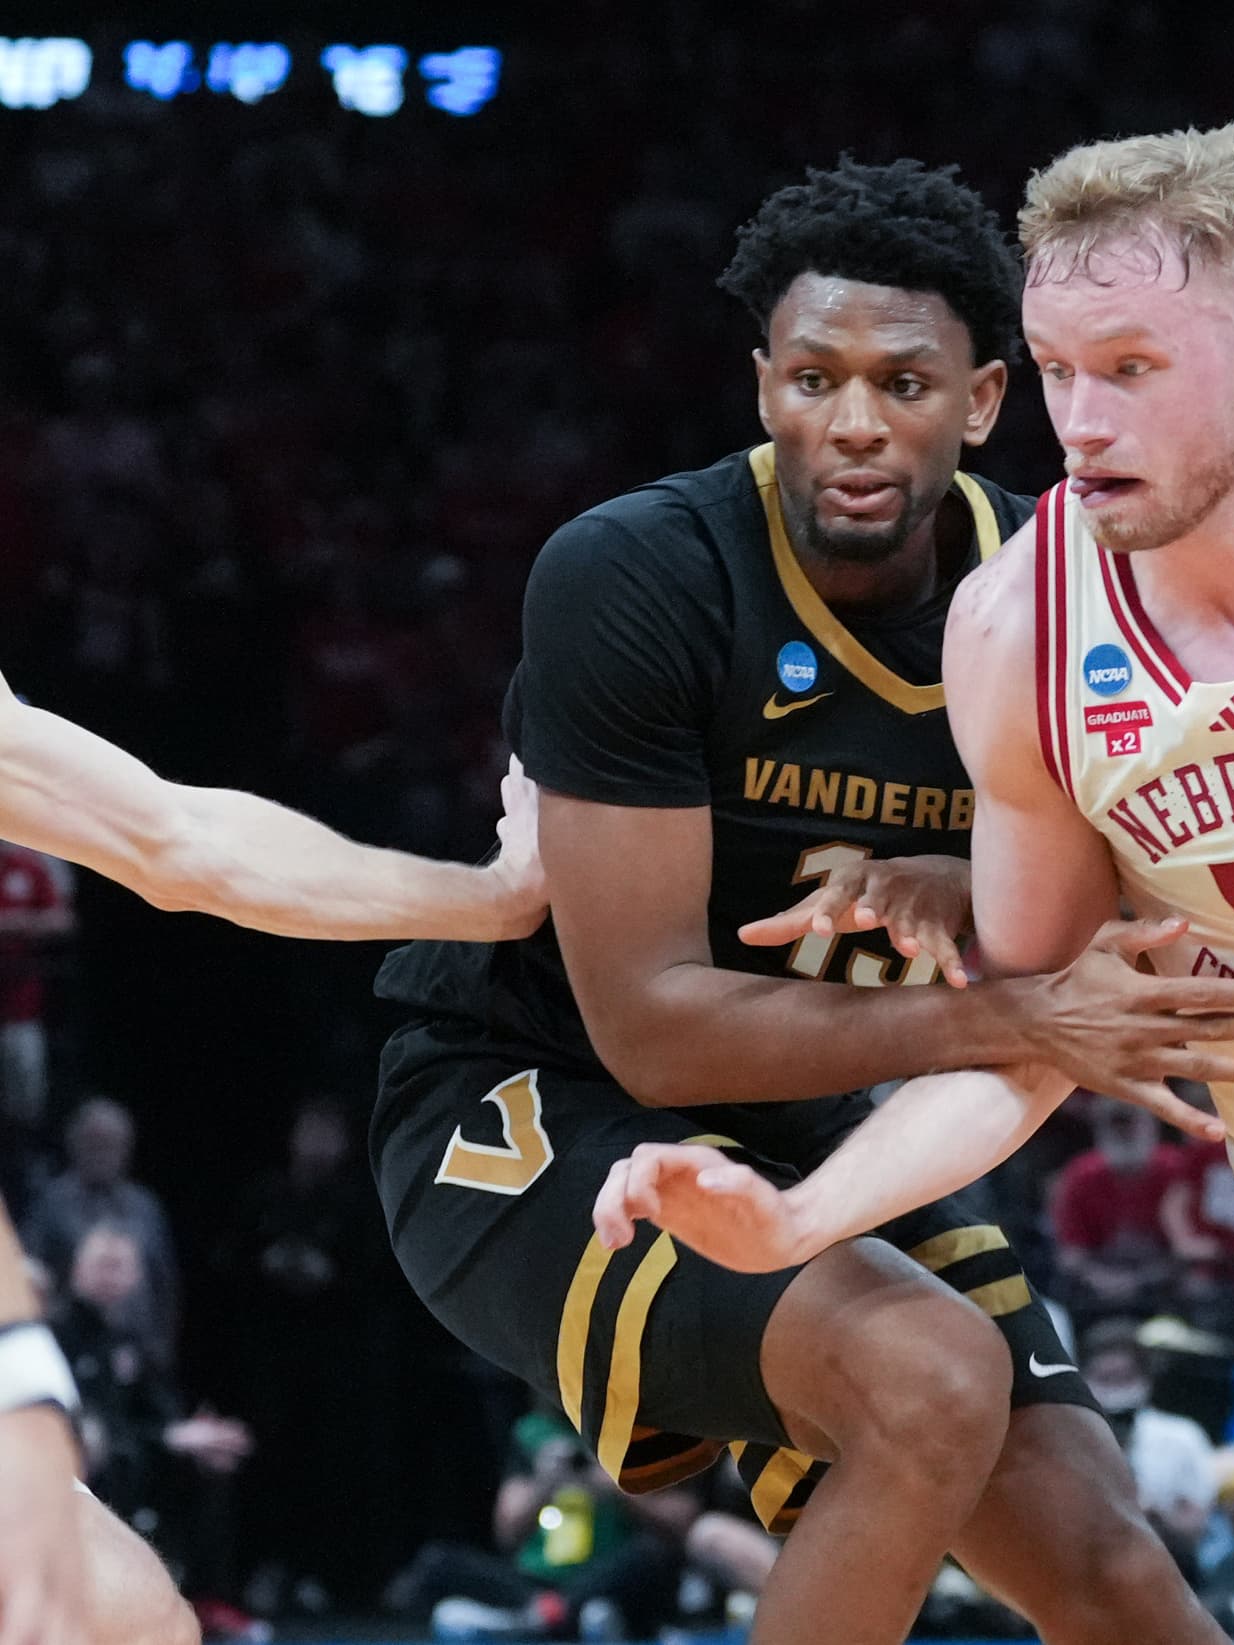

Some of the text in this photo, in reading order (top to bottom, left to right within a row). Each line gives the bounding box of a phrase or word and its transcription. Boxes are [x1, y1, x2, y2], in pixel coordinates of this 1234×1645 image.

[1088, 667, 1129, 684] NCAA
[1087, 708, 1150, 726] GRADUATE
[1111, 732, 1137, 753] x2
[434, 1068, 555, 1196] V
